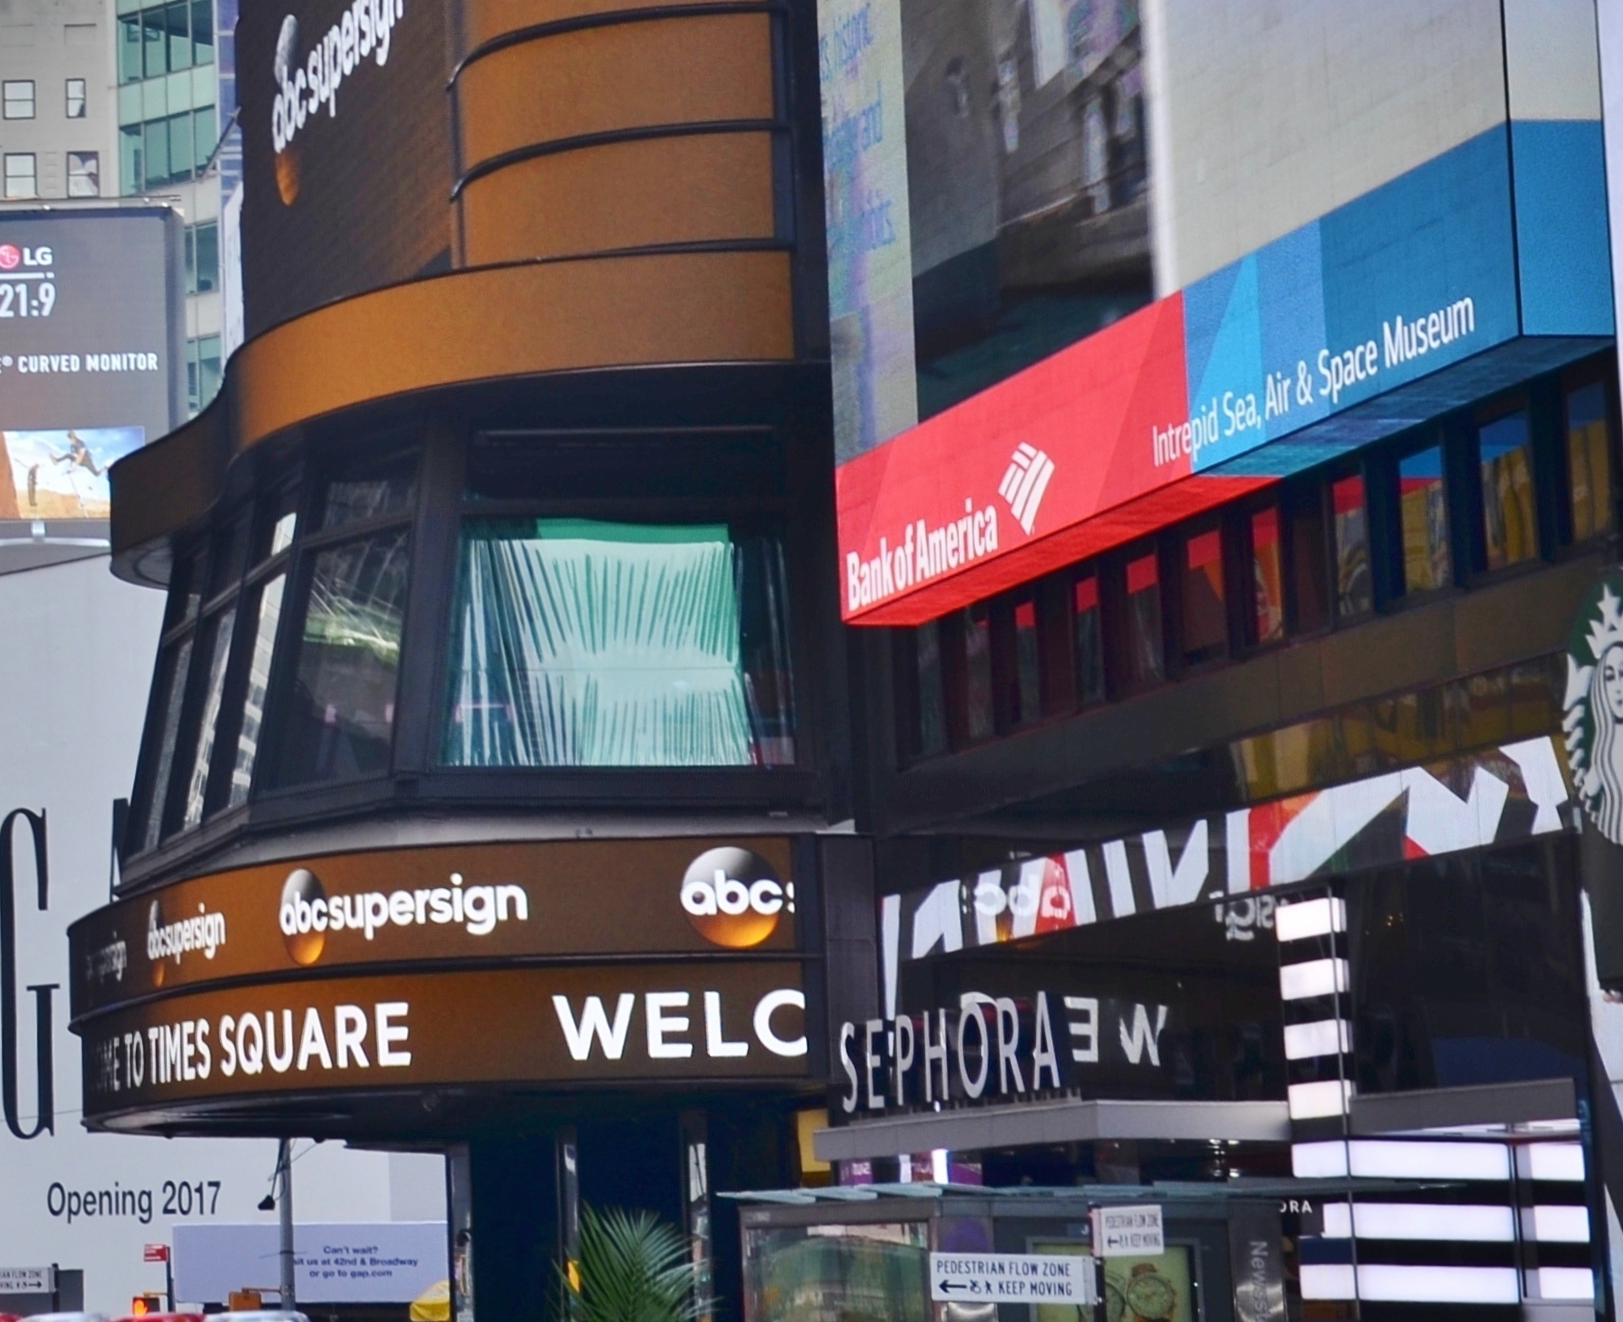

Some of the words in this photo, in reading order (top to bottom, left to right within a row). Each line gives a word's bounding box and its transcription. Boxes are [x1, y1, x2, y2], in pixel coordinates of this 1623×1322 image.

[23, 247, 53, 265] LG
[17, 355, 81, 373] CURVED
[85, 353, 158, 372] MONITOR
[1151, 397, 1219, 467] Intrepid
[1223, 391, 1262, 436] Sea,
[1265, 372, 1291, 420] Air
[1296, 360, 1314, 405] &
[1317, 341, 1378, 404] Space
[1383, 297, 1475, 369] Museum
[846, 536, 894, 612] Bank
[893, 523, 914, 591] of
[916, 497, 999, 583] America
[125, 1031, 144, 1088] TO
[148, 1018, 212, 1084] TIMES
[220, 1001, 413, 1077] SQUARE
[553, 988, 808, 1061] WELC
[840, 990, 1061, 1114] SEPHORA
[46, 1181, 153, 1224] Opening
[162, 1180, 223, 1216] 2017
[323, 1245, 350, 1255] Can't
[352, 1245, 378, 1255] wait?
[321, 1258, 333, 1266] at
[334, 1257, 356, 1266] 42nd
[360, 1258, 367, 1266] &
[370, 1257, 418, 1268] Broadway
[937, 1260, 1005, 1275] PEDESTRIAN
[1008, 1262, 1039, 1276] FLOW
[1042, 1262, 1071, 1277] ZONE
[322, 1270, 335, 1279] go
[337, 1269, 348, 1277] to
[351, 1270, 393, 1280] gap.com
[999, 1281, 1026, 1296] KEEP
[1030, 1281, 1073, 1296] MOVING
